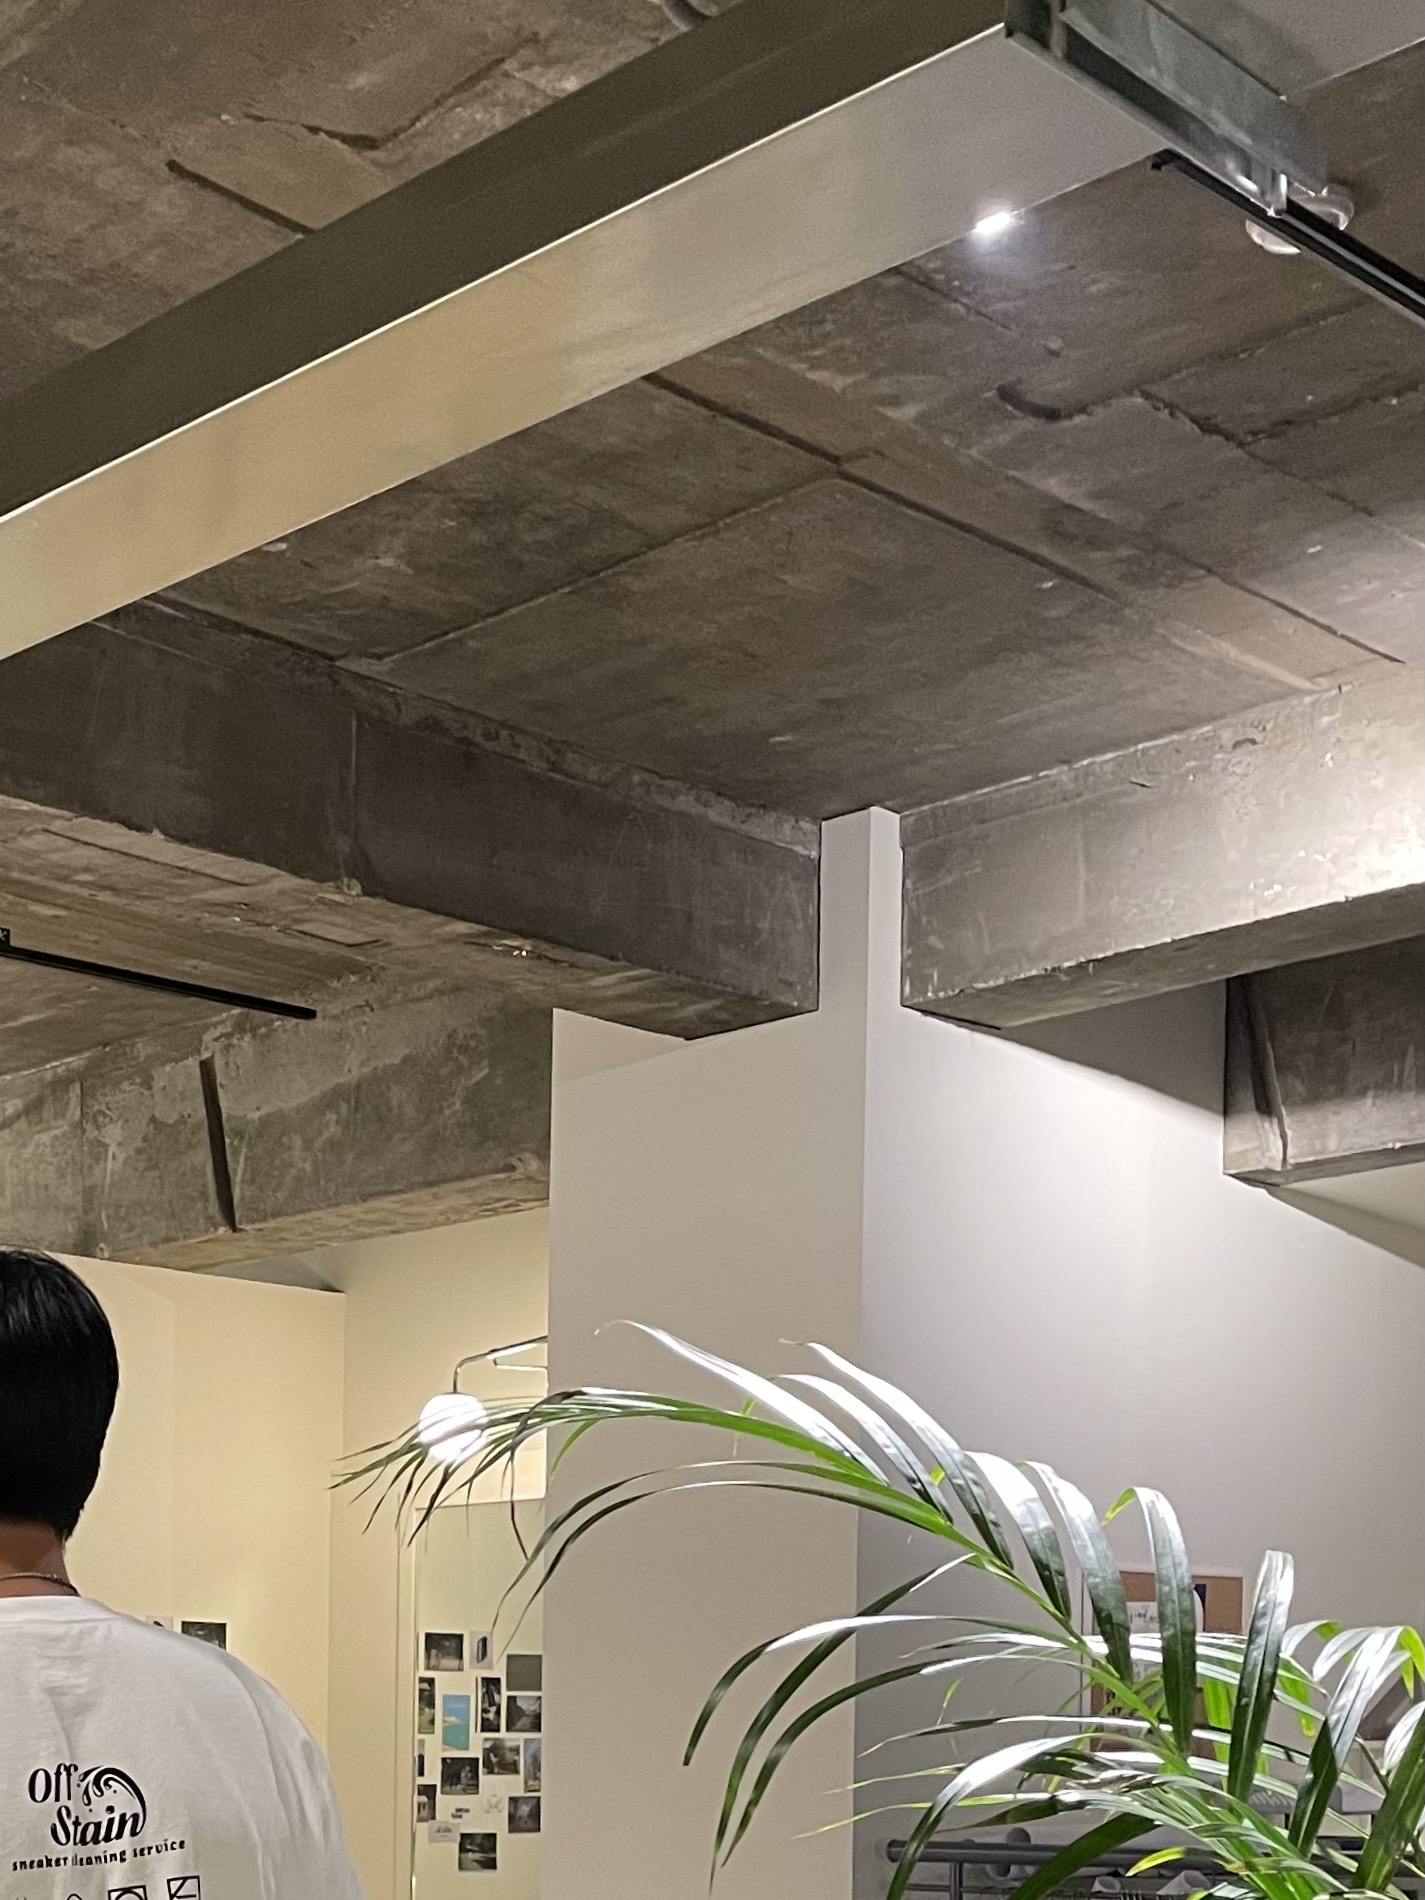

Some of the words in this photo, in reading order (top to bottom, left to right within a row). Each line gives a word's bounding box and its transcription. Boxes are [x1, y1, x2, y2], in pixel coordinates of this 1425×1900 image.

[28, 1763, 78, 1803] Off
[51, 1805, 143, 1846] Stain
[12, 1855, 68, 1871] sneaker
[133, 1839, 185, 1858] service
